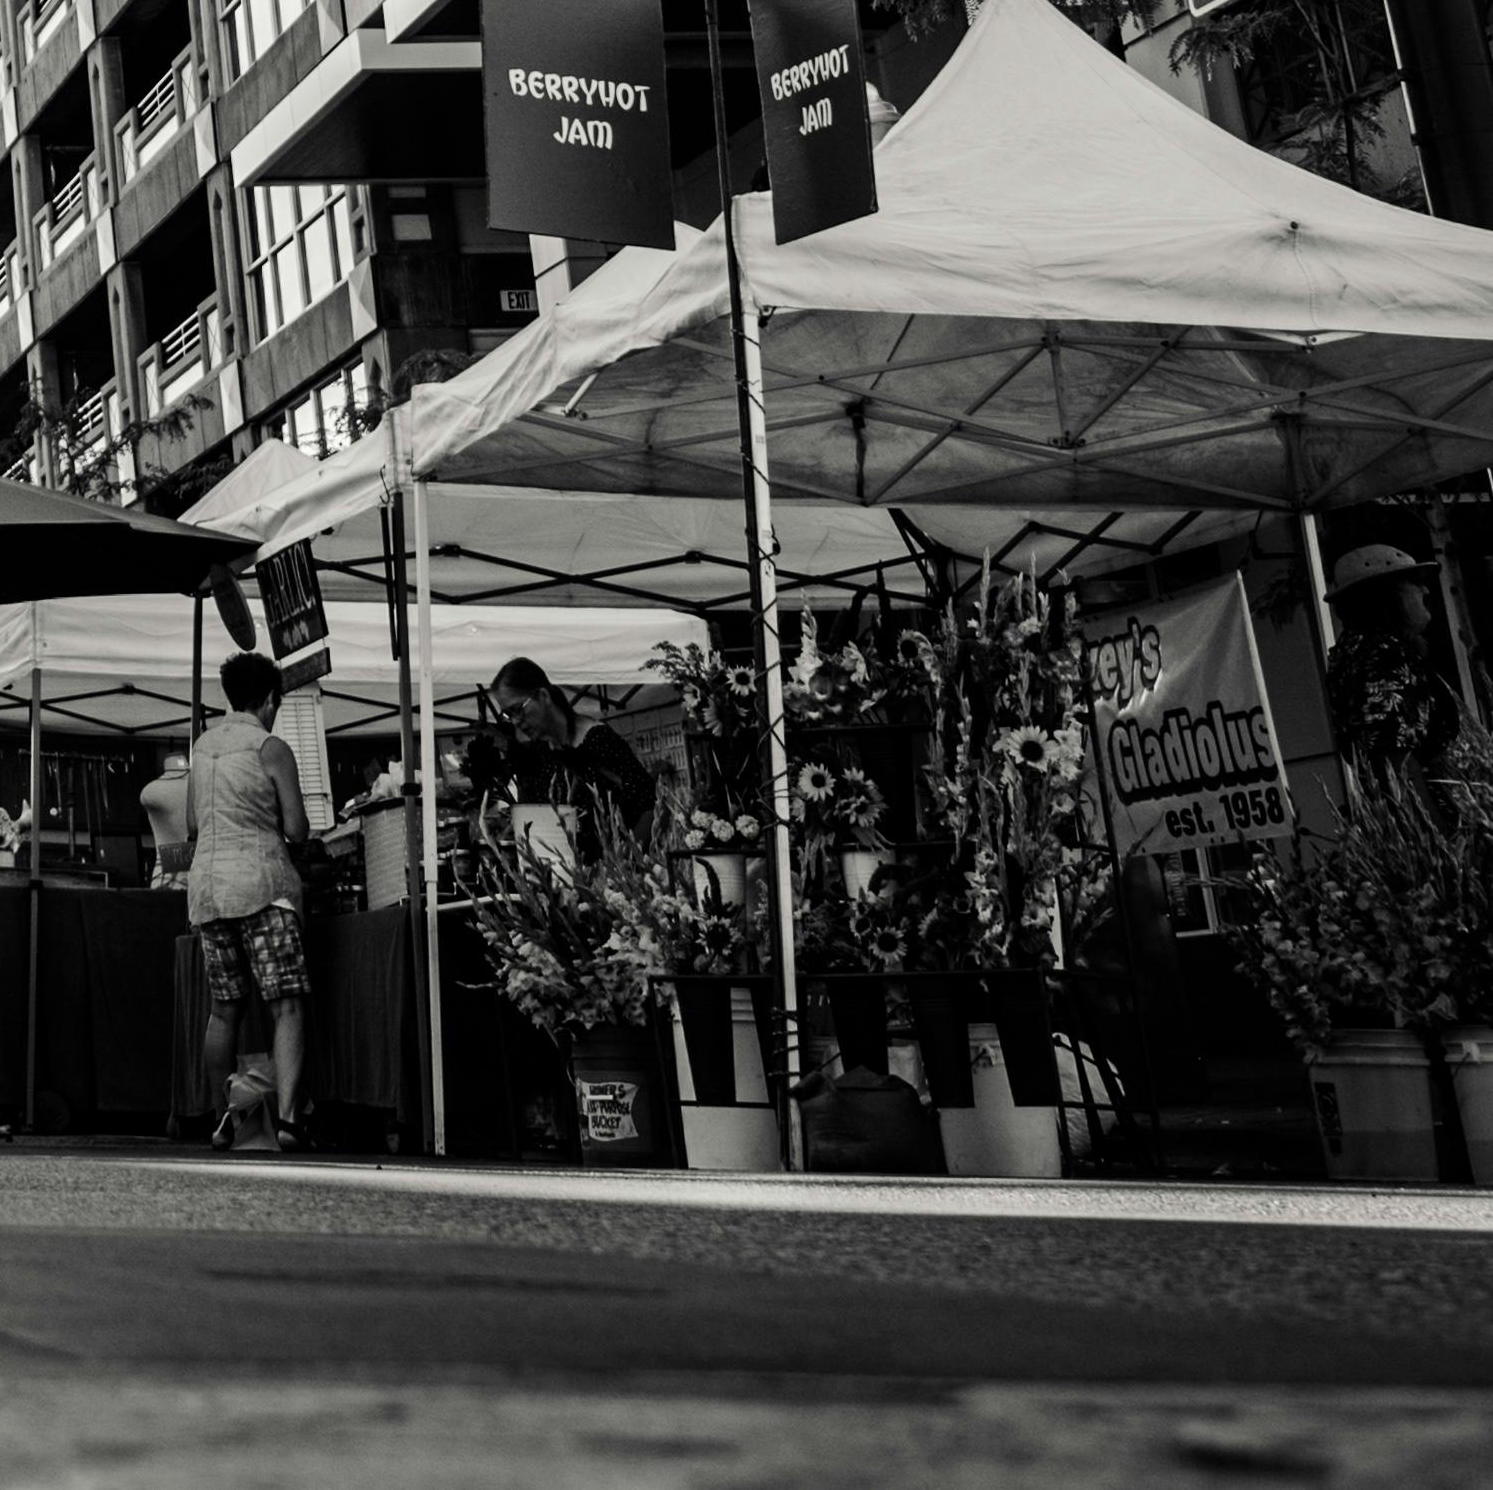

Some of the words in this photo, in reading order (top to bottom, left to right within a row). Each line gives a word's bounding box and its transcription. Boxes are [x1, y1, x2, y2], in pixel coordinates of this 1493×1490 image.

[508, 68, 651, 113] BERRYHOT
[769, 43, 850, 102] BERRYHOT
[553, 116, 614, 151] JAM
[798, 96, 833, 137] JAM
[506, 290, 531, 310] EXIT
[1108, 700, 1279, 806] Gladiolus
[1165, 801, 1215, 838] est.
[1218, 786, 1285, 830] 1958
